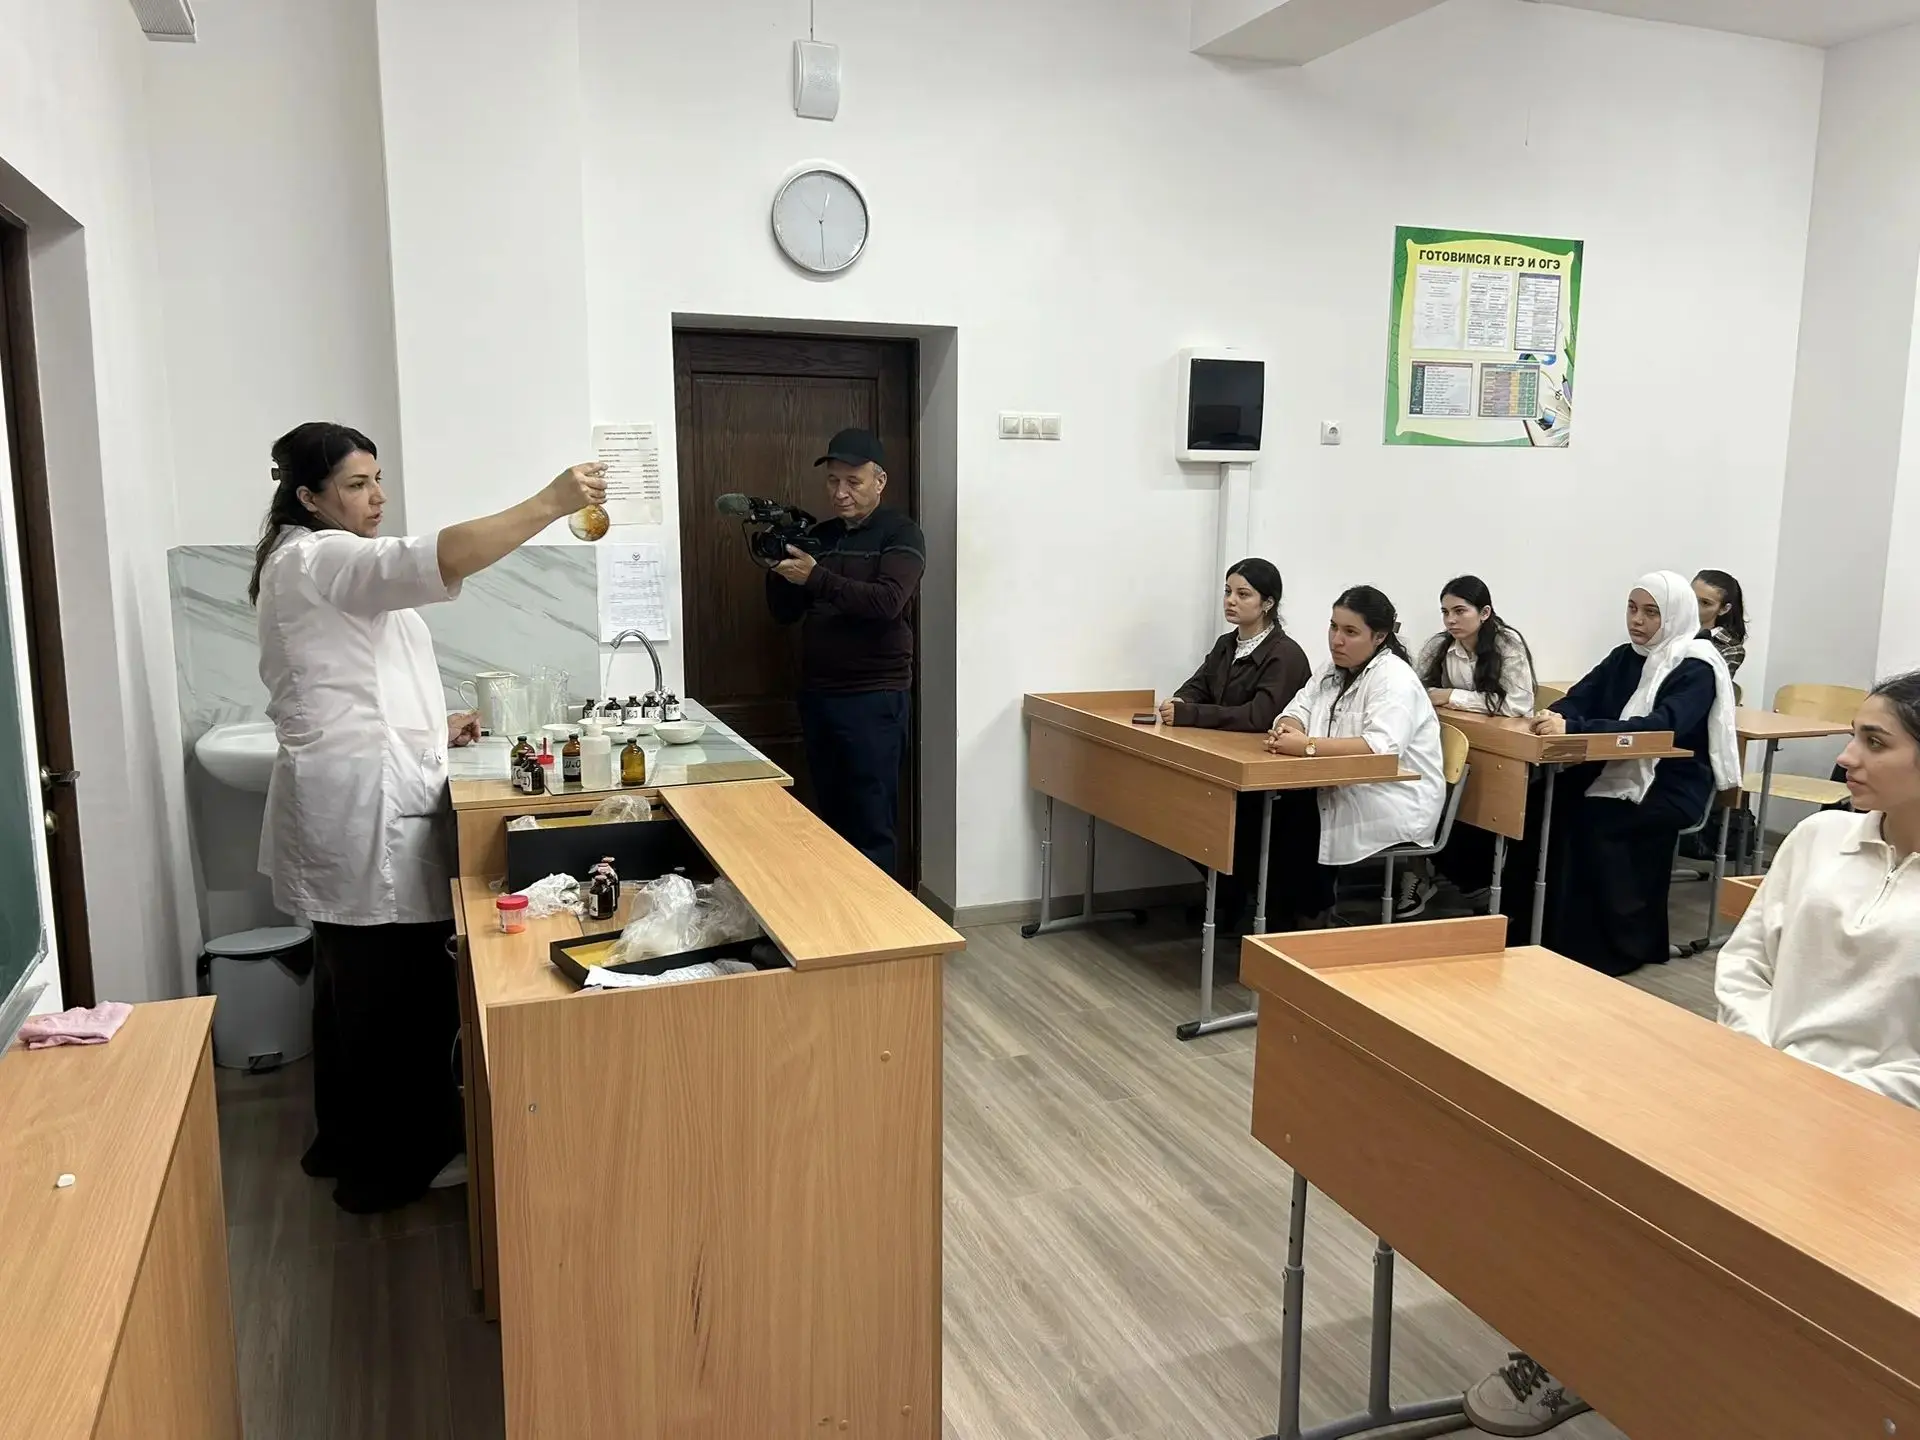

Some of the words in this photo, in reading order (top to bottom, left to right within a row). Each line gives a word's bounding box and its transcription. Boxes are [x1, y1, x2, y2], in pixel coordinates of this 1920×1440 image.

[1419, 249, 1490, 265] ГОТОВИМСЯ
[1493, 254, 1501, 266] К
[1504, 256, 1524, 267] ЕГЭ
[1528, 258, 1536, 268] И
[1538, 259, 1561, 270] ОГЭ
